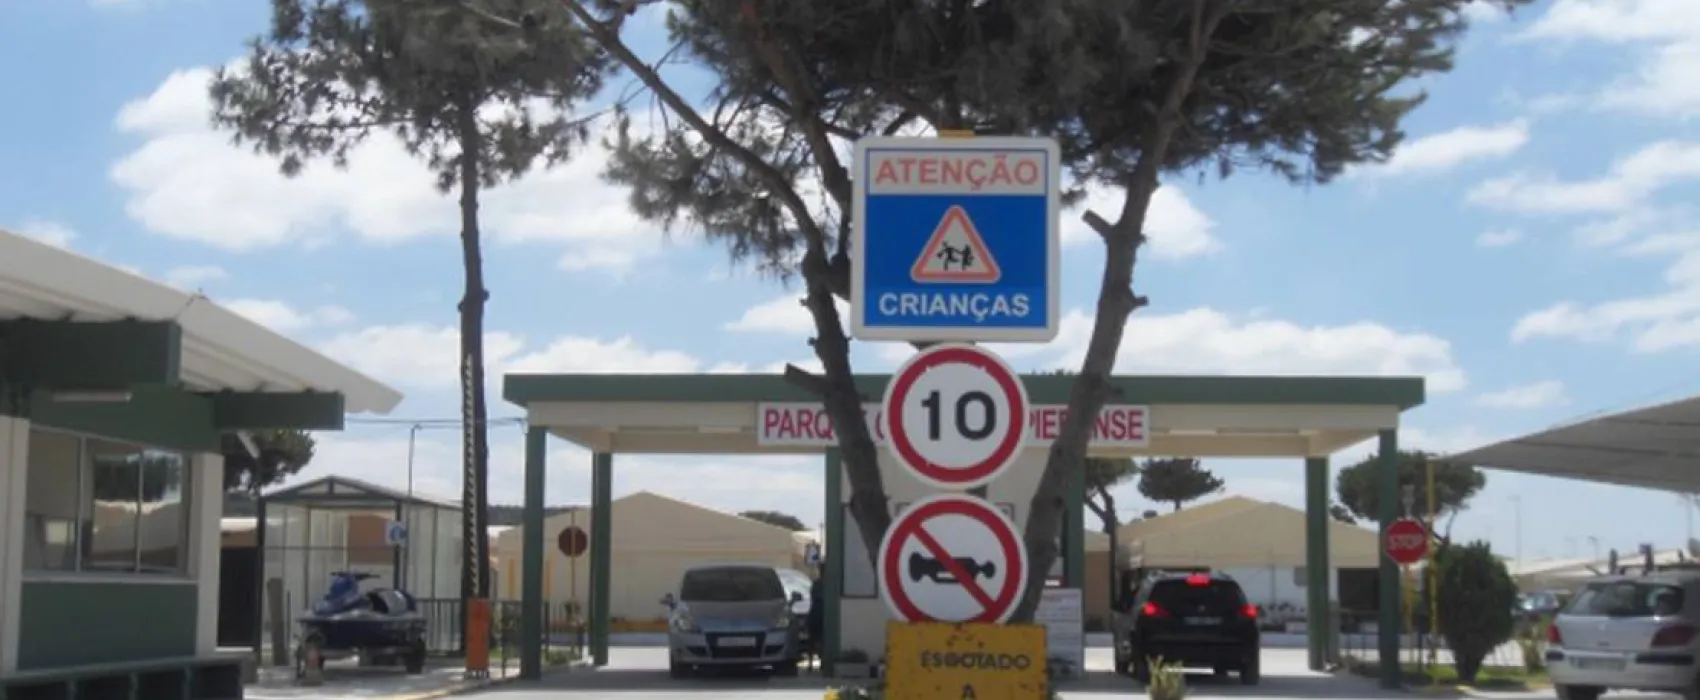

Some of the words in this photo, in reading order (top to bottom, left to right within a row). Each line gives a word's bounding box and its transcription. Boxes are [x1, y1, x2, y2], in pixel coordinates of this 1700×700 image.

[874, 154, 1039, 190] ATENÇÃO
[878, 292, 1030, 322] CRIANÇAS
[764, 408, 836, 441] PARQ
[1029, 408, 1145, 440] IENSE
[921, 389, 997, 441] 10
[1388, 533, 1424, 550] STOP
[920, 651, 1031, 670] ESGOTADO
